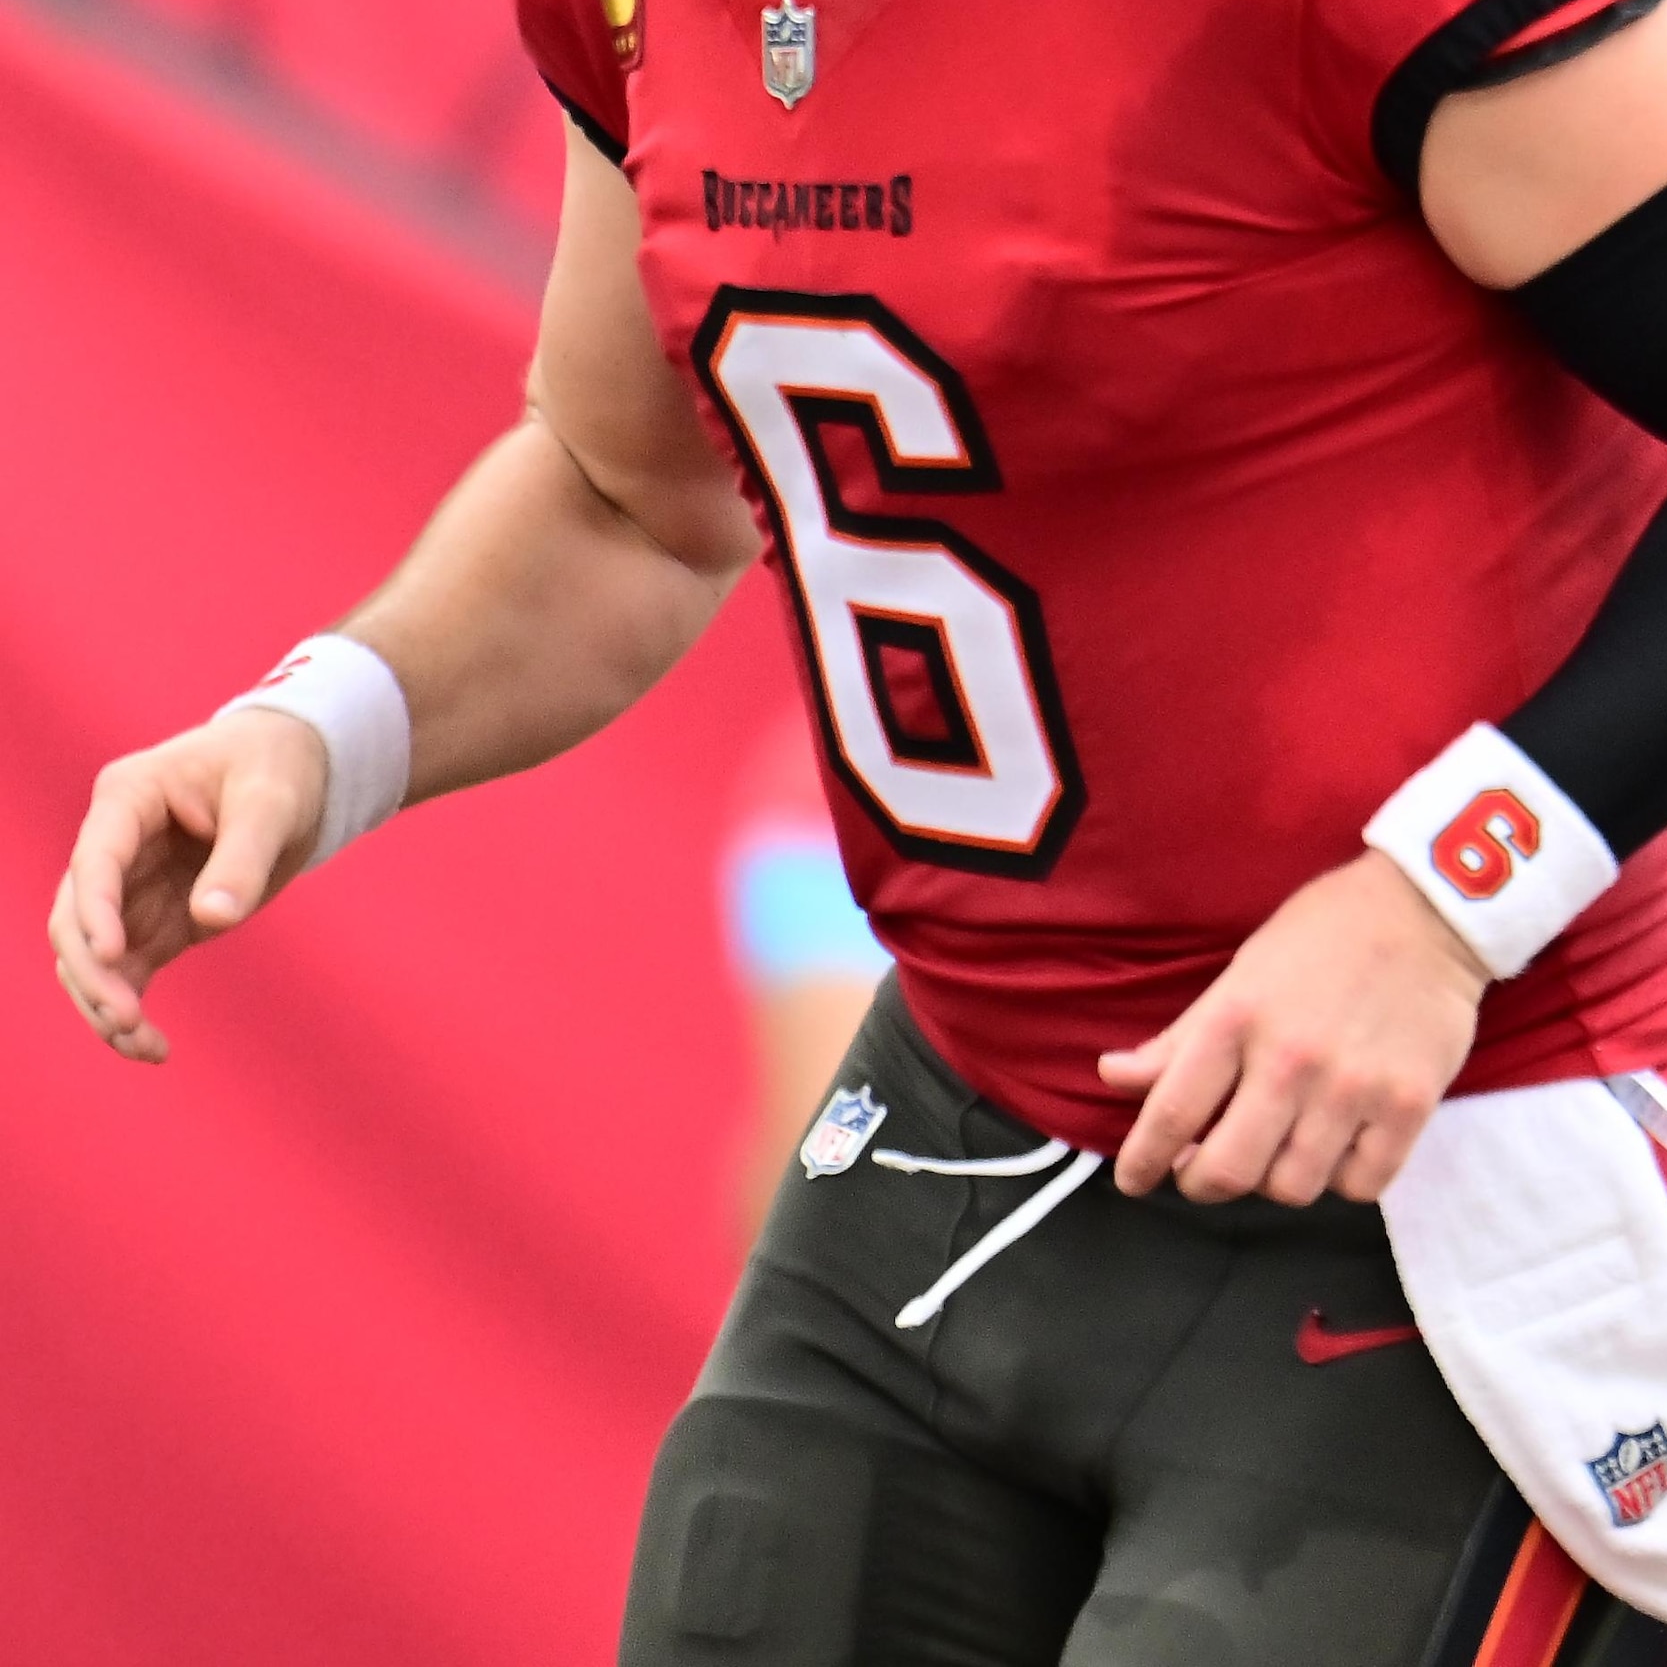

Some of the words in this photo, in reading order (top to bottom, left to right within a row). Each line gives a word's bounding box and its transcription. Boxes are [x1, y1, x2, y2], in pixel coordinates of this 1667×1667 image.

[703, 169, 912, 243] BUCCANEERS
[689, 284, 1088, 882] 6
[1430, 787, 1542, 901] 6
